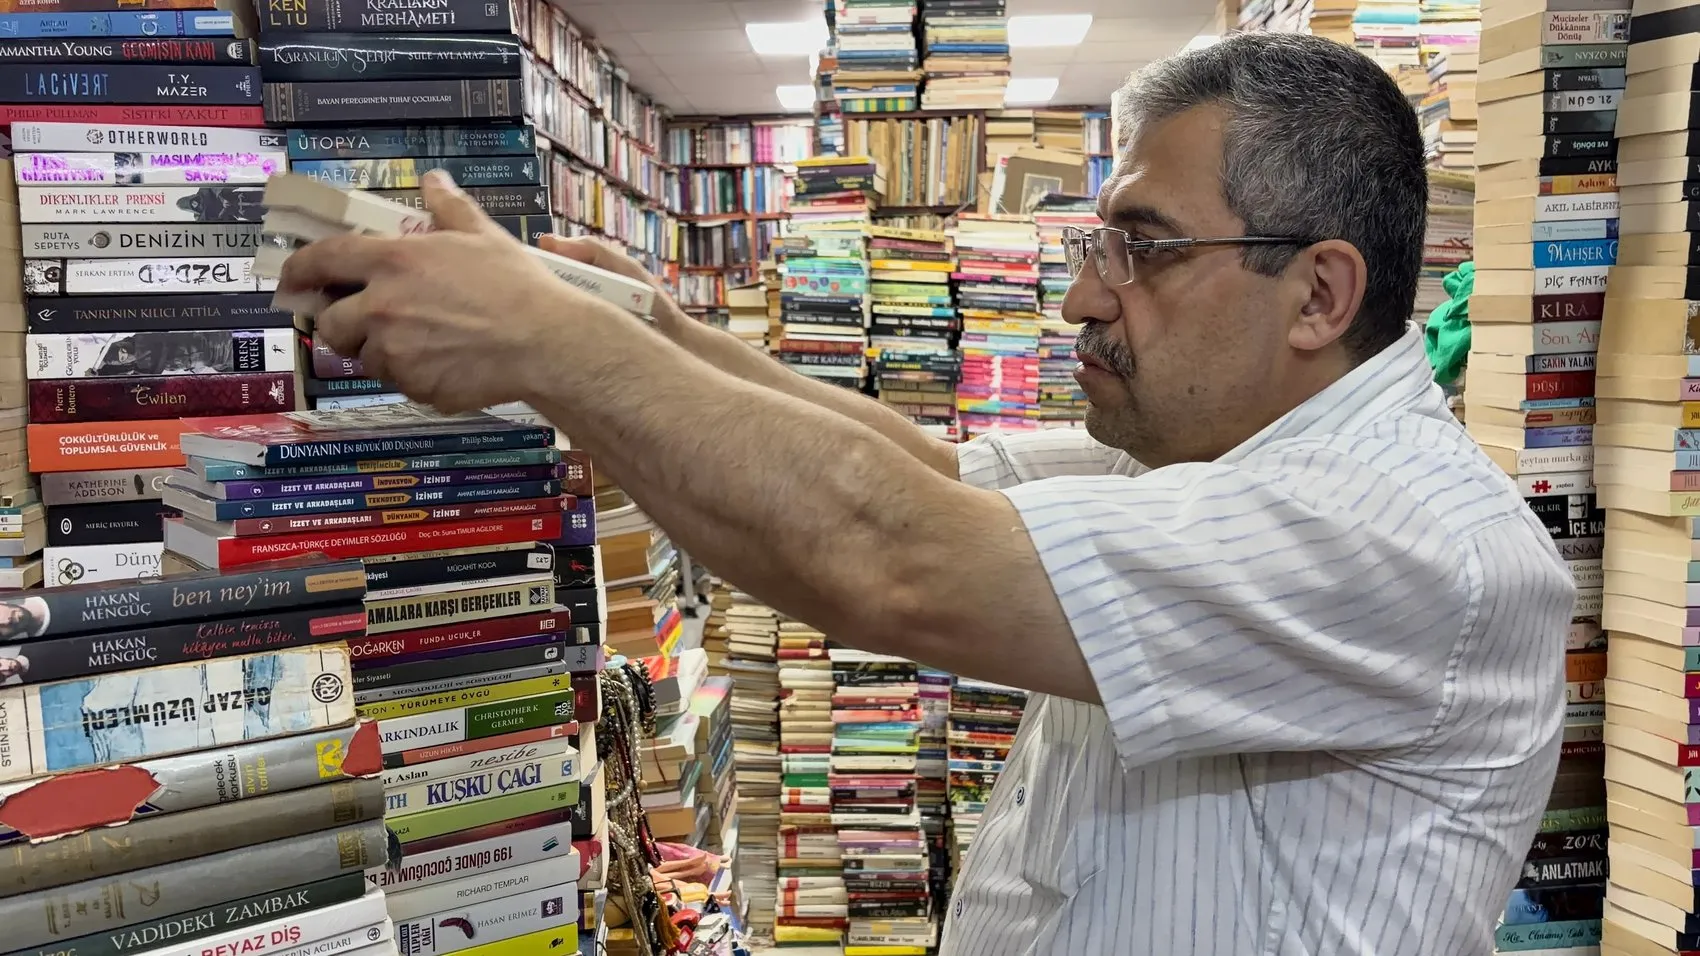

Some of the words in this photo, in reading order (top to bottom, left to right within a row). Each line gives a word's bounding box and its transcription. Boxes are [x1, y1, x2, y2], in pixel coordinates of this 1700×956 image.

[268, 0, 307, 11] KEN
[270, 12, 308, 26] LIU
[361, 10, 455, 28] MERHAMETİ
[1551, 14, 1589, 23] Mucizeler
[1557, 32, 1583, 41] Dönüş
[0, 45, 61, 57] AMANTHA
[62, 42, 113, 56] YOUNG
[168, 74, 195, 84] T.Y.
[157, 86, 207, 97] MAZER
[389, 96, 411, 104] TUHAF
[412, 95, 452, 104] ÇOCUKLARI
[1598, 94, 1612, 104] 21.
[1568, 95, 1595, 107] GÜN
[6, 109, 42, 119] PHILIP
[46, 109, 98, 118] PULLMAN
[178, 109, 228, 120] YAKUT
[108, 130, 208, 146] OTHERWORLD
[298, 134, 370, 150] ÜTOPYA
[126, 192, 166, 205] PRENSİ
[1544, 203, 1570, 212] AKIL
[43, 232, 70, 240] RUTA
[120, 229, 205, 248] DENİZİN
[212, 233, 265, 248] TUZU
[34, 241, 80, 250] SEPETYS
[108, 269, 135, 277] ERTEM
[1544, 275, 1565, 288] PİÇ
[73, 309, 137, 321] TANRI'NIN
[140, 308, 176, 319] KILICI
[181, 306, 221, 317] ATTİLA
[1540, 328, 1571, 345] Son
[1541, 357, 1566, 369] SAKIN
[1568, 355, 1594, 368] YALAN
[56, 388, 64, 412] Pierre
[67, 385, 77, 414] Bottero
[59, 431, 146, 446] ÇOKKÜLTÜRLÜLÜK
[462, 436, 482, 445] Philip
[482, 435, 504, 443] Stokes
[60, 444, 118, 456] TOPLUMSAL
[120, 442, 168, 453] GÜVENLİK
[280, 442, 341, 459] DÜNYANIN
[343, 443, 354, 453] EN
[381, 441, 394, 450] 100
[264, 466, 285, 475] İZZET
[287, 466, 297, 474] VE
[299, 464, 348, 474] ARKADAŞLARI
[411, 459, 440, 468] İZİNDE
[1520, 453, 1549, 468] şeytan
[1551, 451, 1582, 463] marka
[68, 478, 127, 489] KATHERINE
[281, 484, 301, 492] İZZET
[315, 481, 363, 490] ARKADAŞLARI
[423, 475, 451, 484] İZİNDE
[74, 487, 125, 498] ADDISON
[272, 502, 293, 511] İZZET
[294, 501, 304, 509] VE
[306, 499, 355, 508] ARKADAŞLARI
[415, 491, 443, 500] İZİNDE
[1547, 503, 1562, 512] KIR
[289, 519, 311, 528] İZZET
[324, 515, 372, 525] ARKADAŞLARI
[432, 508, 461, 518] İZİNDE
[1568, 520, 1587, 536] İÇE
[252, 539, 329, 554] FRANSIZCA-TÜRKÇE
[331, 535, 369, 547] DEYİMLER
[115, 552, 162, 569] Düny
[86, 591, 140, 608] HAKAN
[172, 587, 212, 608] ben
[425, 597, 459, 618] KARŞI
[460, 590, 521, 614] GERÇEKLER
[81, 603, 152, 622] MENGÜÇ
[92, 636, 146, 653] HAKAN
[419, 635, 445, 645] FUNDA
[88, 647, 157, 667] MENGÜÇ
[366, 673, 391, 682] Siyaseti
[400, 694, 457, 711] YÜRÜMEYE
[461, 689, 490, 700] ÖVGÜ
[474, 705, 532, 722] CHRISTOPHER
[491, 717, 524, 729] GERMER
[419, 750, 439, 758] UZUN
[470, 746, 537, 769] nesibe
[213, 759, 224, 803] gelecek
[228, 754, 239, 801] korkusu
[244, 764, 256, 794] alvin
[396, 770, 428, 783] Aslan
[426, 772, 493, 807] KUŞKU
[497, 761, 542, 794] ÇAĞI
[455, 850, 491, 871] GÜNDE
[493, 845, 513, 863] 199
[1541, 859, 1603, 881] ANLATMAK
[380, 871, 396, 887] VE
[457, 881, 492, 899] RICHARD
[493, 875, 529, 890] TEMPLAR
[111, 911, 216, 950] VADİDEKİ
[225, 889, 310, 923] ZAMBAK
[477, 916, 505, 928] HASAN
[508, 907, 538, 922] ERİMEZ
[201, 935, 266, 956] BEYAZ
[271, 924, 301, 946] DİŞ
[411, 923, 421, 954] ALPLER
[422, 926, 431, 947] ÇAĞI
[313, 937, 352, 955] ACILARI
